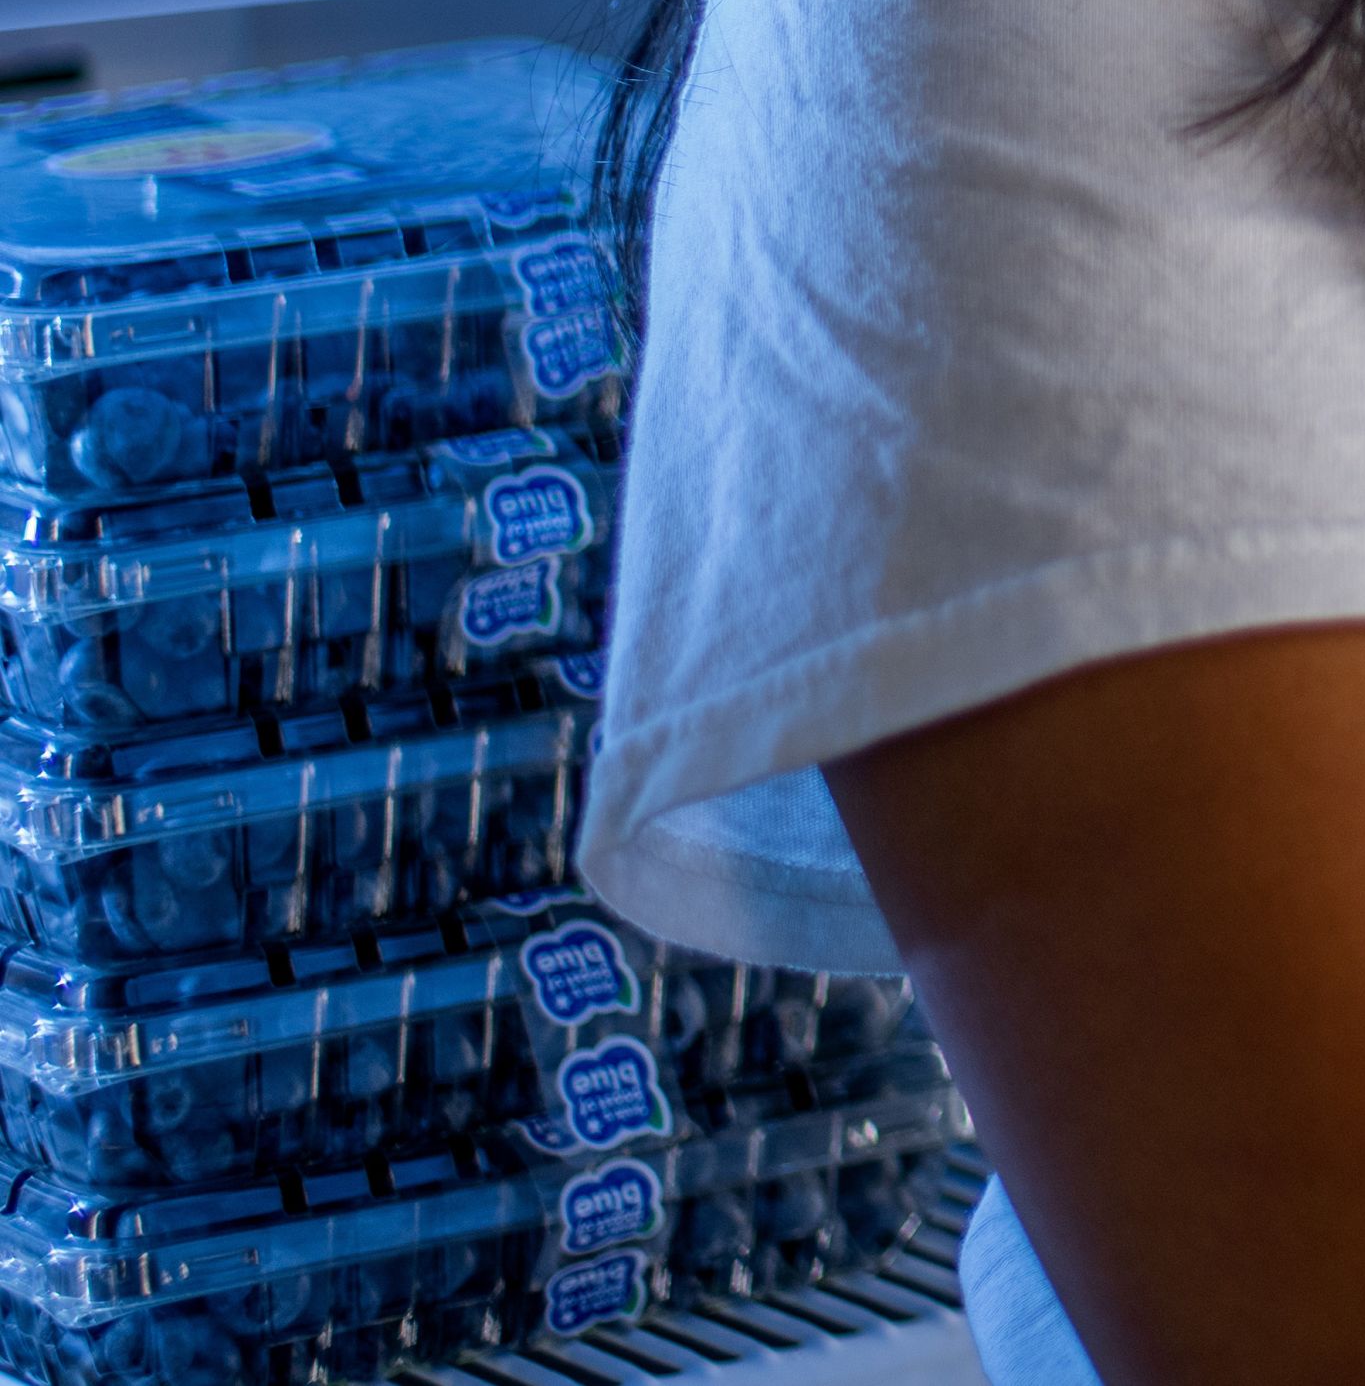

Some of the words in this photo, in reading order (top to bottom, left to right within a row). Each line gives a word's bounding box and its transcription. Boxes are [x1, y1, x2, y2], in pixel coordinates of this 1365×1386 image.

[499, 484, 571, 519] blue
[535, 940, 610, 974] blue
[572, 1059, 641, 1098] blue
[574, 1180, 642, 1219] blue
